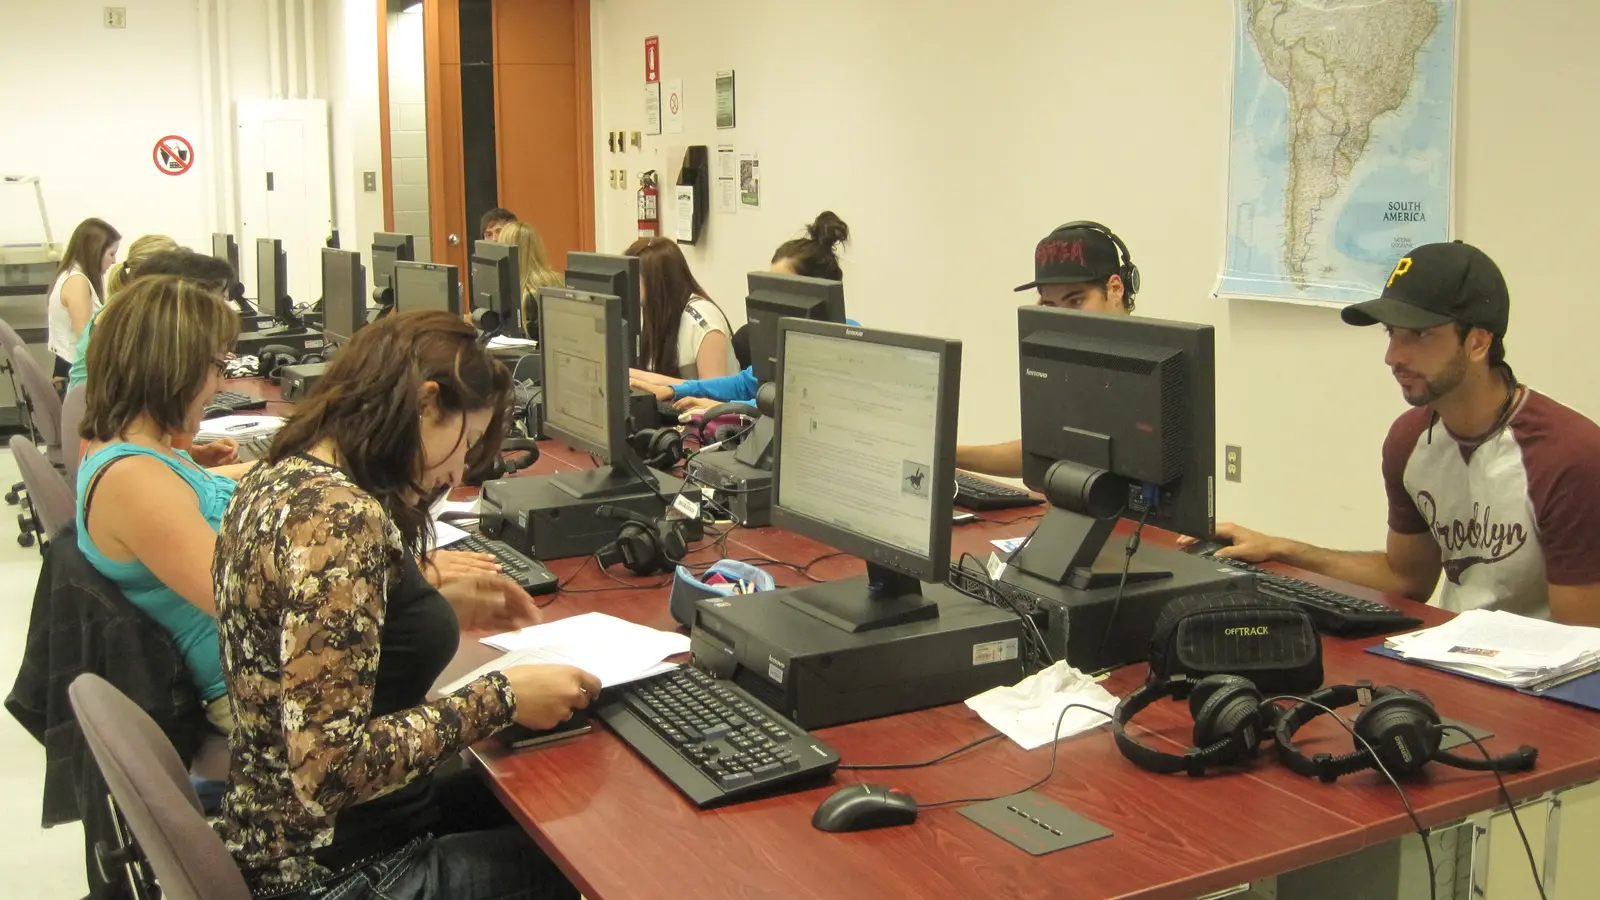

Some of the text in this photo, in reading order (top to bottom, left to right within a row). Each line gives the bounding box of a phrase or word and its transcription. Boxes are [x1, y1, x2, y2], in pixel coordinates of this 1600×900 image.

[1388, 201, 1421, 211] SOUTH
[1383, 212, 1426, 222] AMERICA
[1386, 257, 1413, 288] P
[1025, 368, 1048, 379] lenovo
[1224, 626, 1269, 636] OFFTRACK
